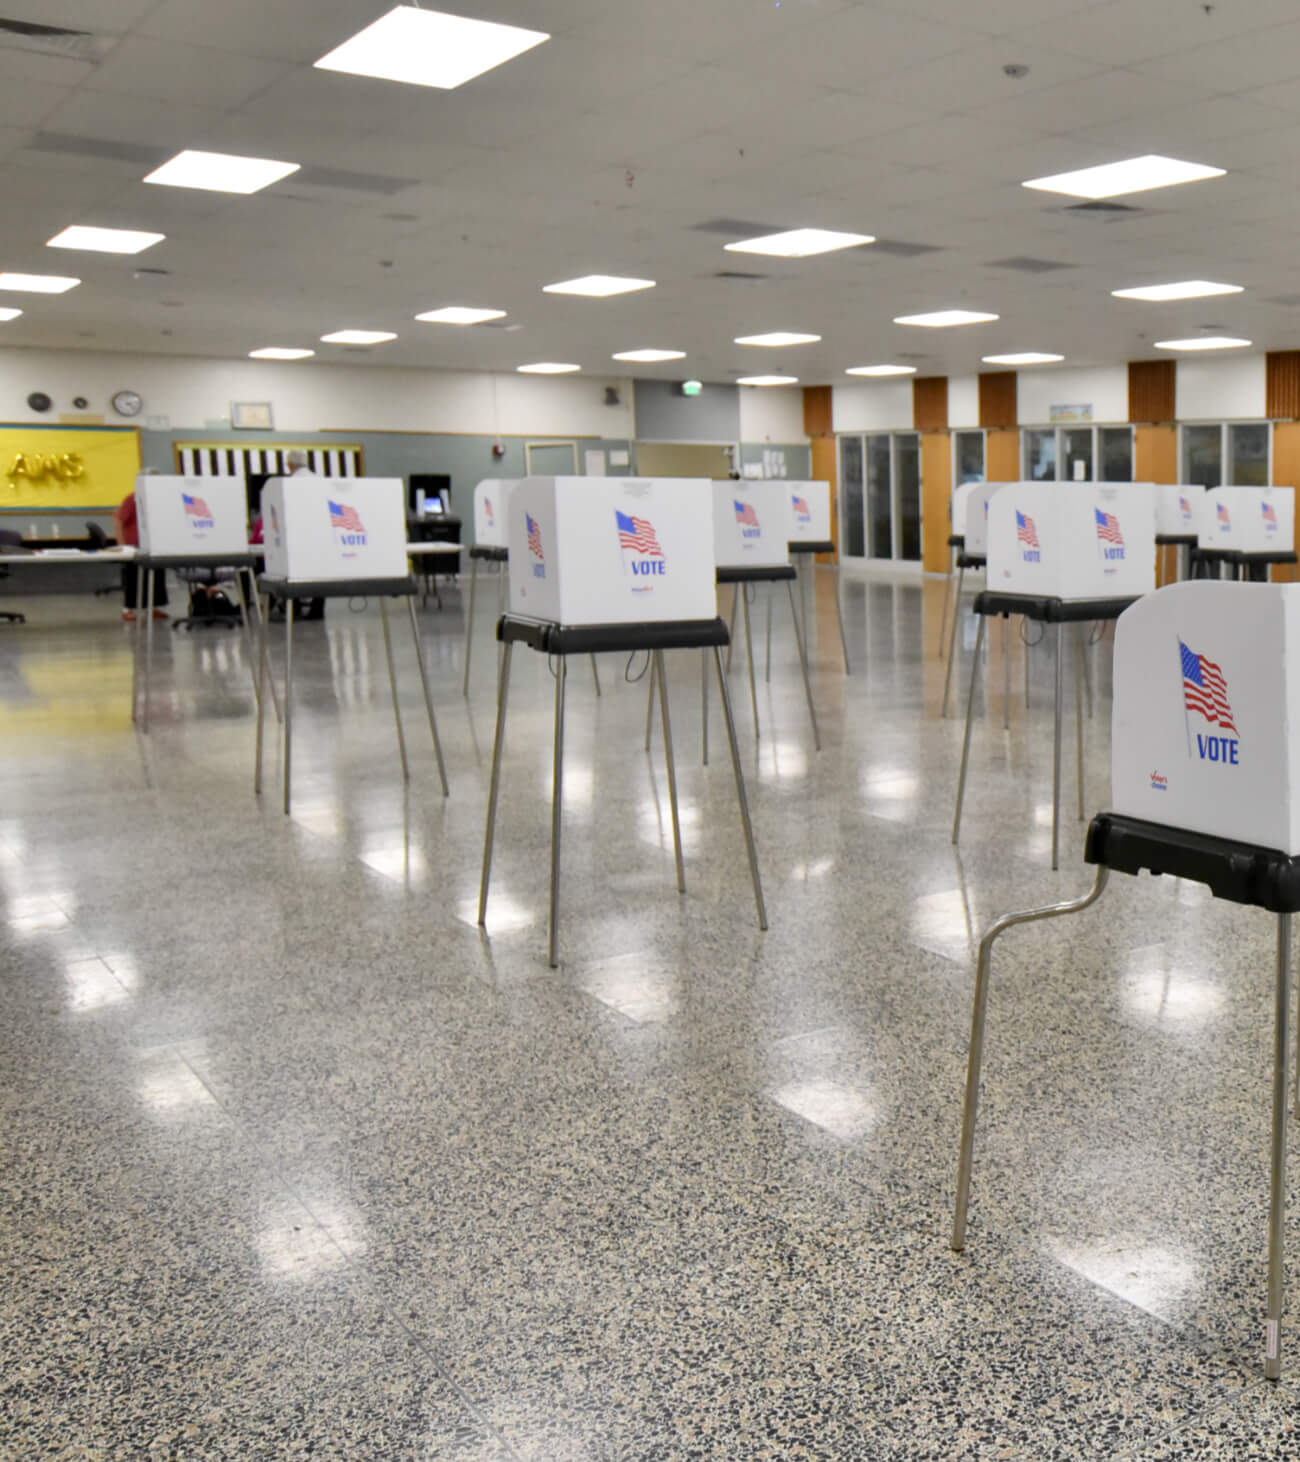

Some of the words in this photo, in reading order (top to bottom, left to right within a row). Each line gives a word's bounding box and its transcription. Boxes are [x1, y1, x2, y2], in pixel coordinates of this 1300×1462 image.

[341, 535, 367, 546] VOTE
[1023, 550, 1041, 563] VOTE
[1104, 547, 1125, 561] VOTE
[632, 560, 665, 577] VOTE
[1197, 734, 1239, 765] VOTE
